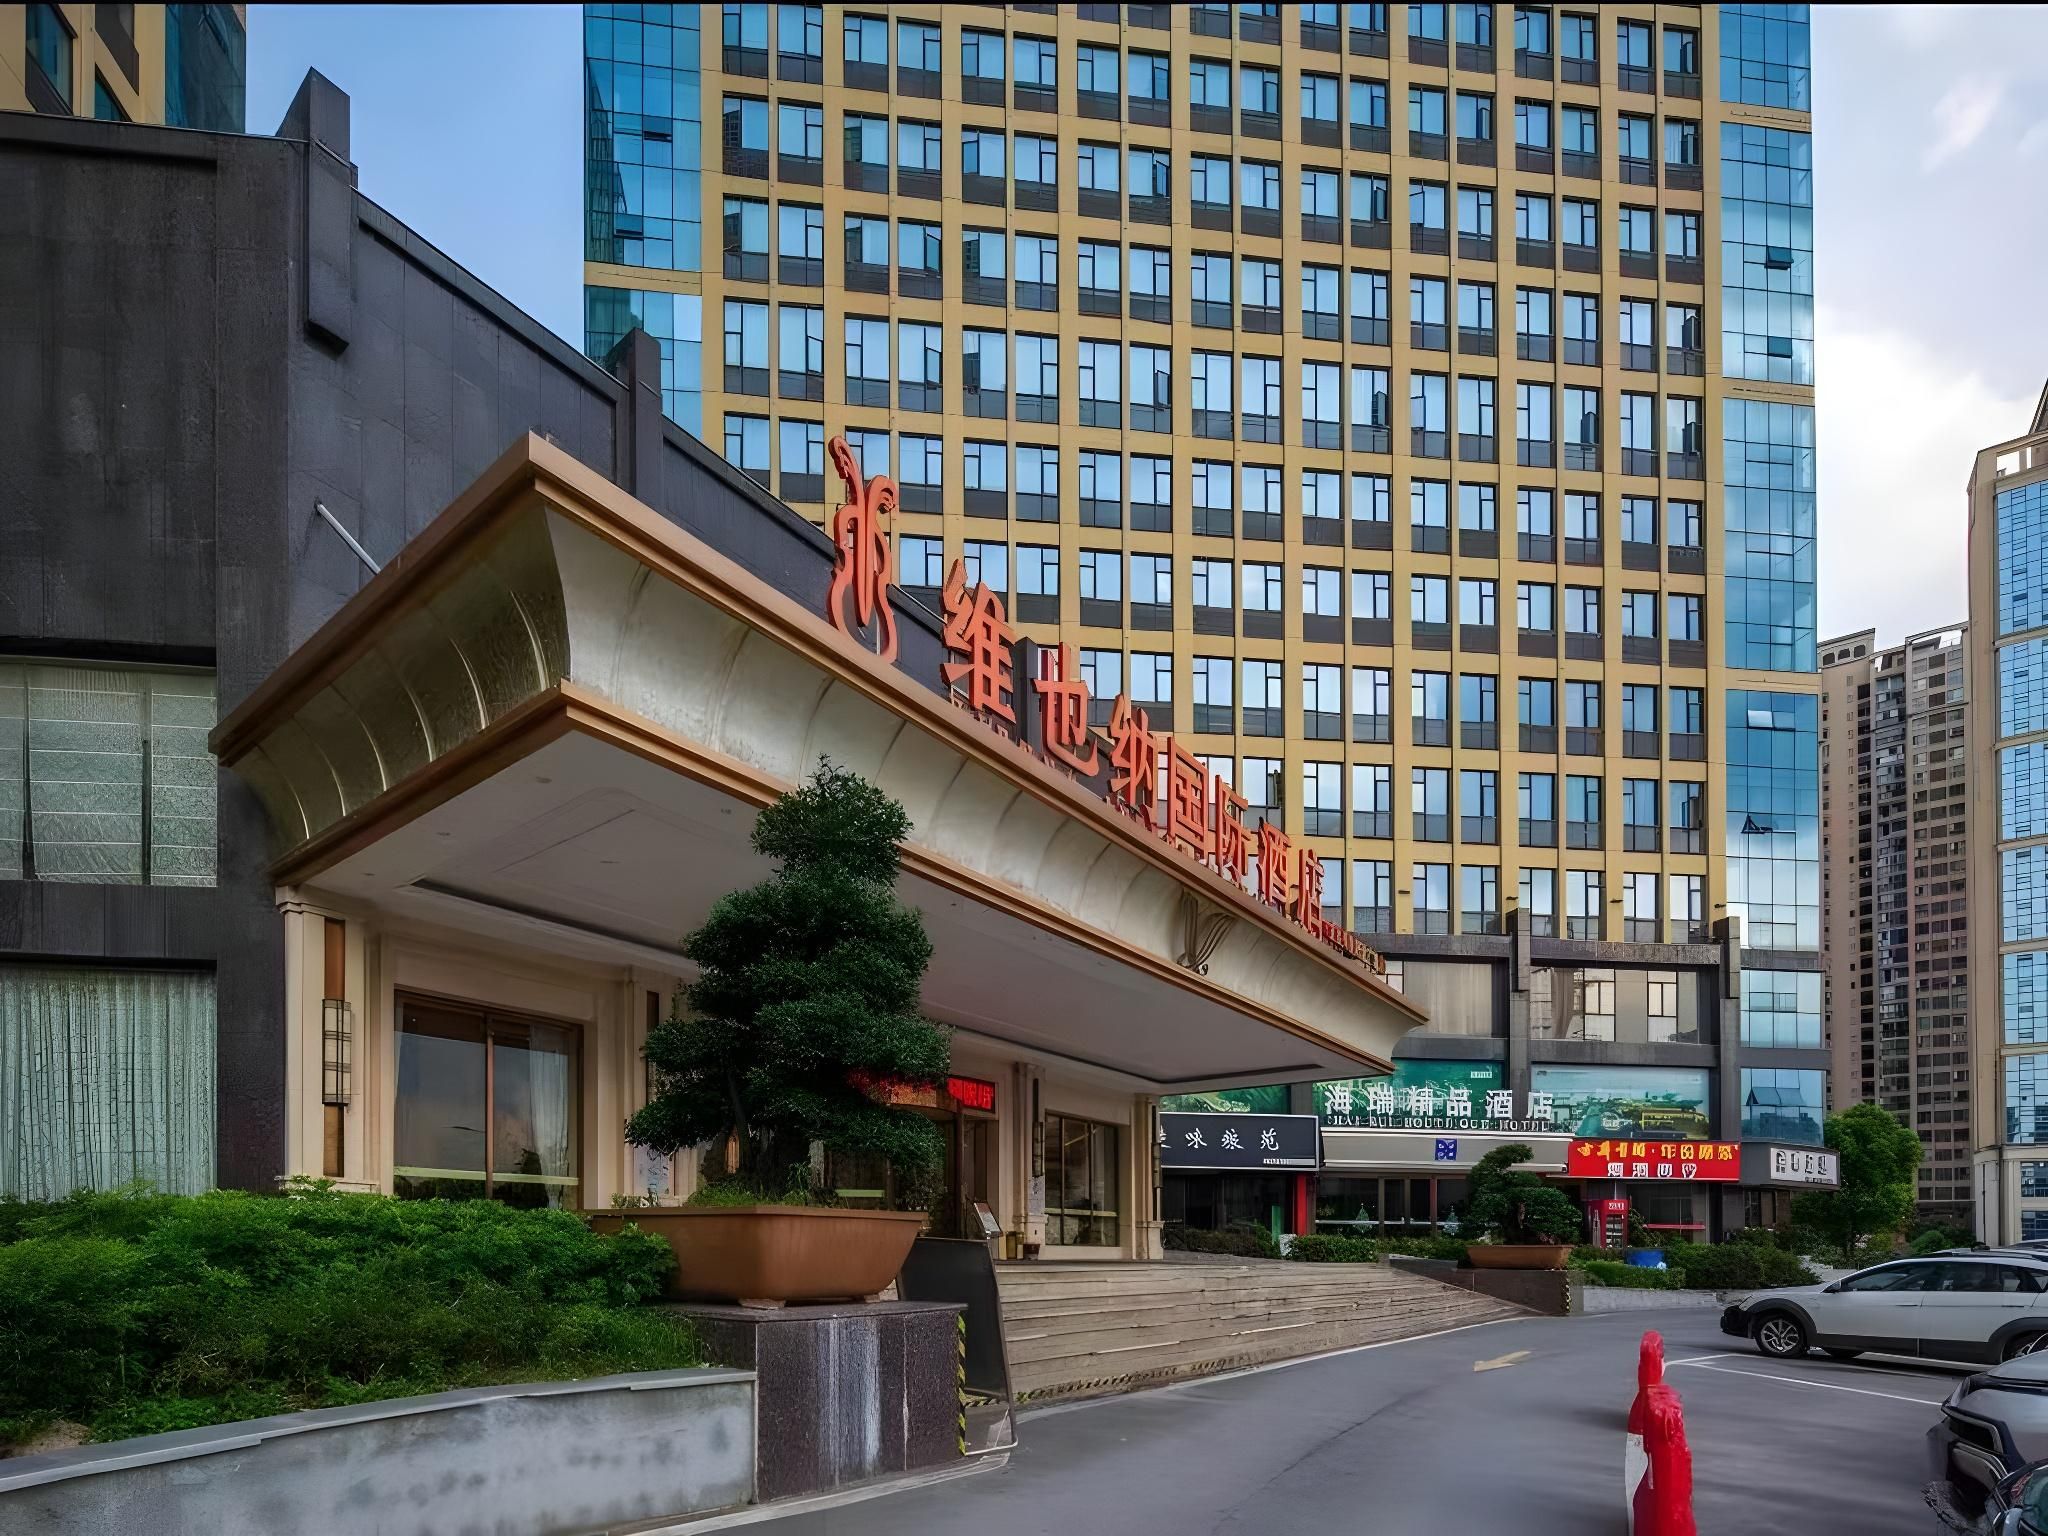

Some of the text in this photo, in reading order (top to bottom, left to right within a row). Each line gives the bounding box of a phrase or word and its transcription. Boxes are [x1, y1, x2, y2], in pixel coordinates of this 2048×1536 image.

[940, 558, 1324, 942] 维也纳国际酒店
